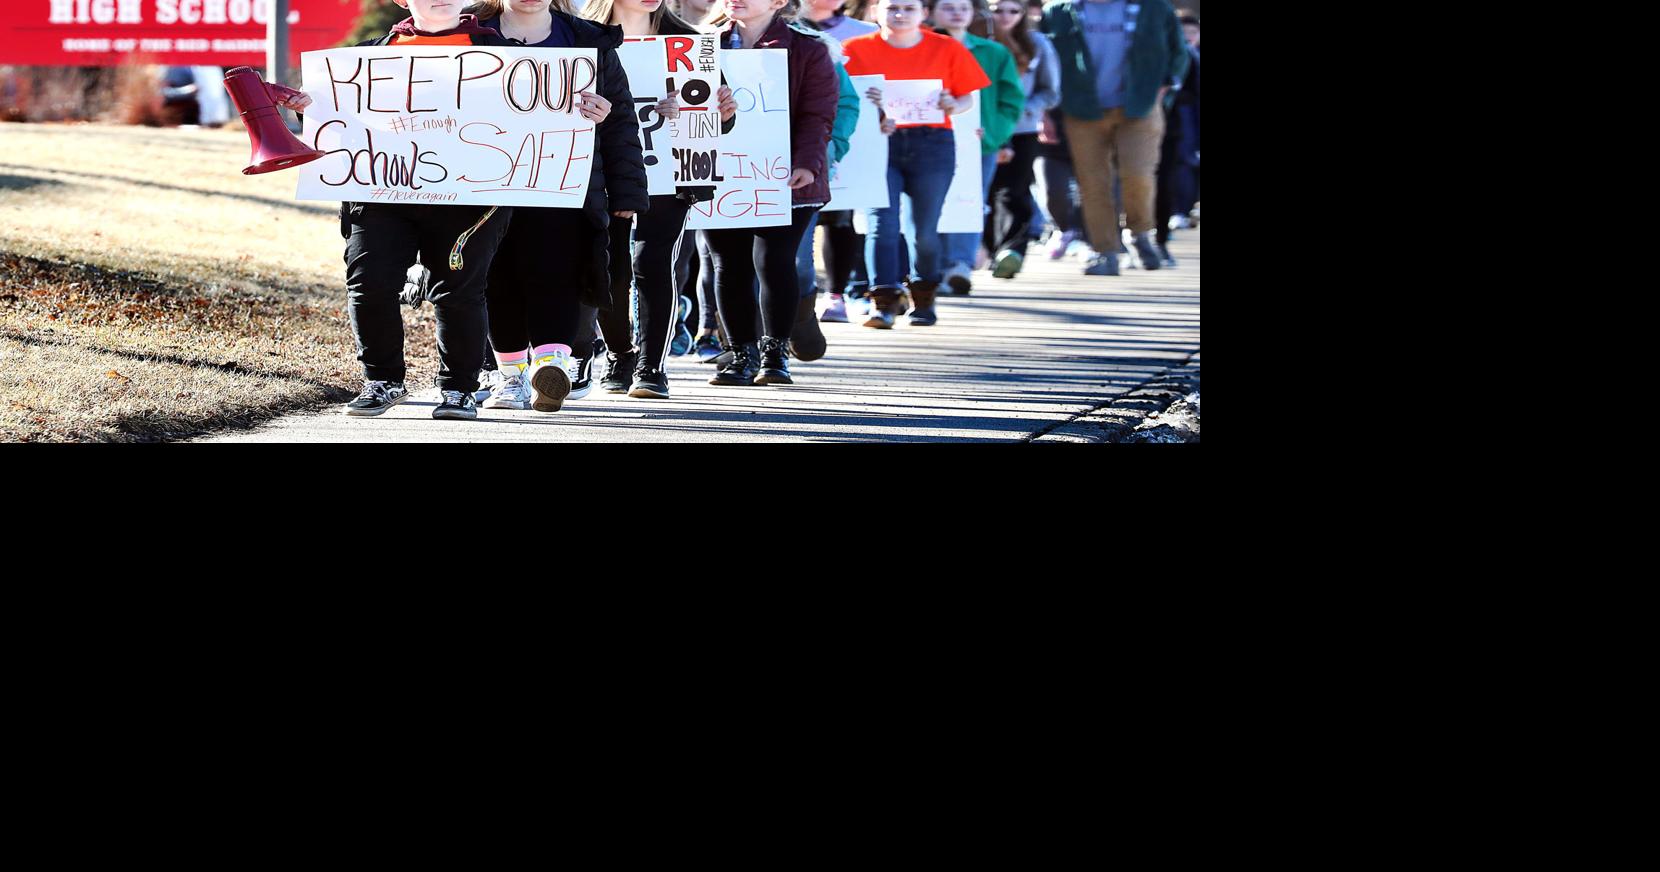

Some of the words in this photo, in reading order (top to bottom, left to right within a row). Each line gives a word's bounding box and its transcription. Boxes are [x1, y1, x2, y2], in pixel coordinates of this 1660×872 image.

[49, 0, 142, 24] HIGH
[156, 0, 300, 24] SCHOO
[325, 51, 504, 113] KEEP
[502, 55, 596, 115] OUR
[388, 114, 457, 134] #Enough
[314, 120, 448, 190] Schools
[456, 122, 593, 191] SAFE
[370, 187, 458, 201] #neveragain
